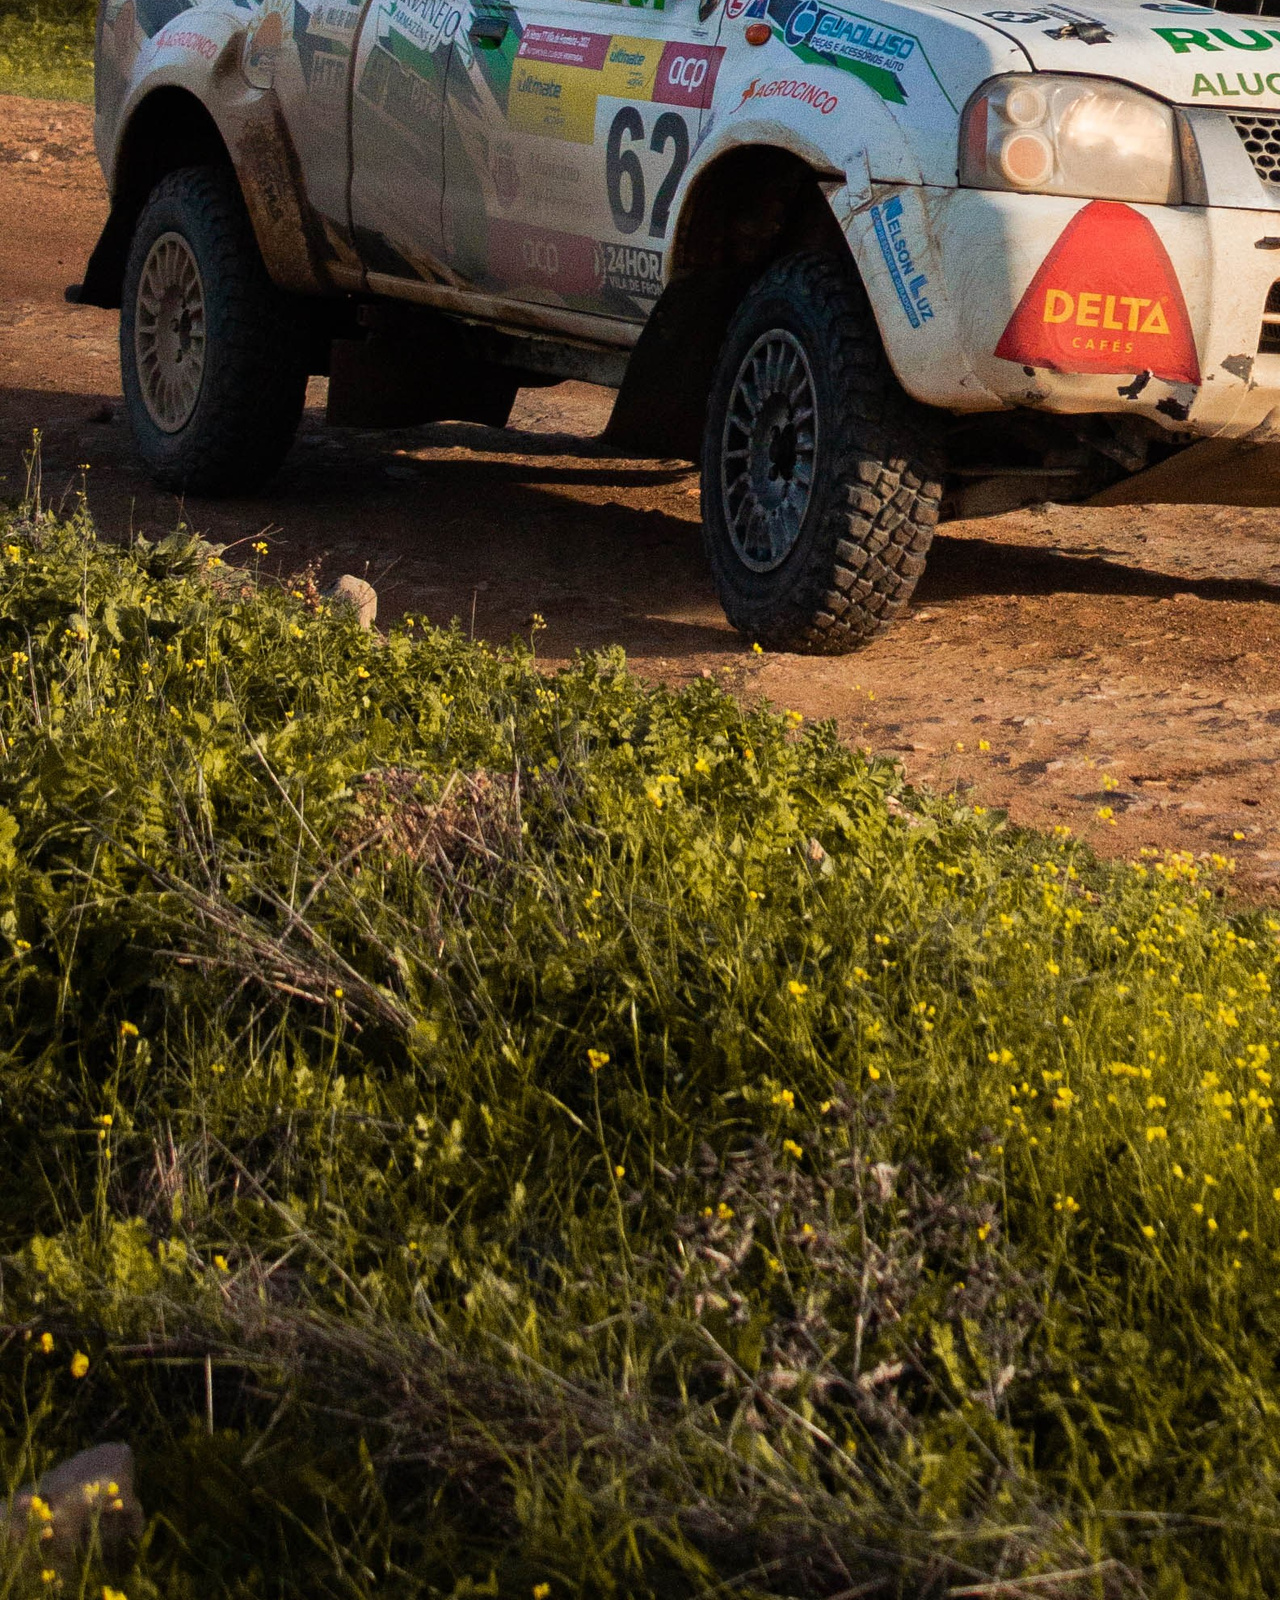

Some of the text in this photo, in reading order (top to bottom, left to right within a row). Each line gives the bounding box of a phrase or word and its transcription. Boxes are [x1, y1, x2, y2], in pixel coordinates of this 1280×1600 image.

[816, 13, 917, 61] GUADILUSO
[668, 56, 709, 93] acp
[751, 80, 839, 114] AGROCINCO
[606, 106, 690, 240] 62
[882, 195, 935, 323] NELSON LUZ
[1042, 288, 1171, 335] DELTA
[1072, 337, 1134, 354] CAFÉS
